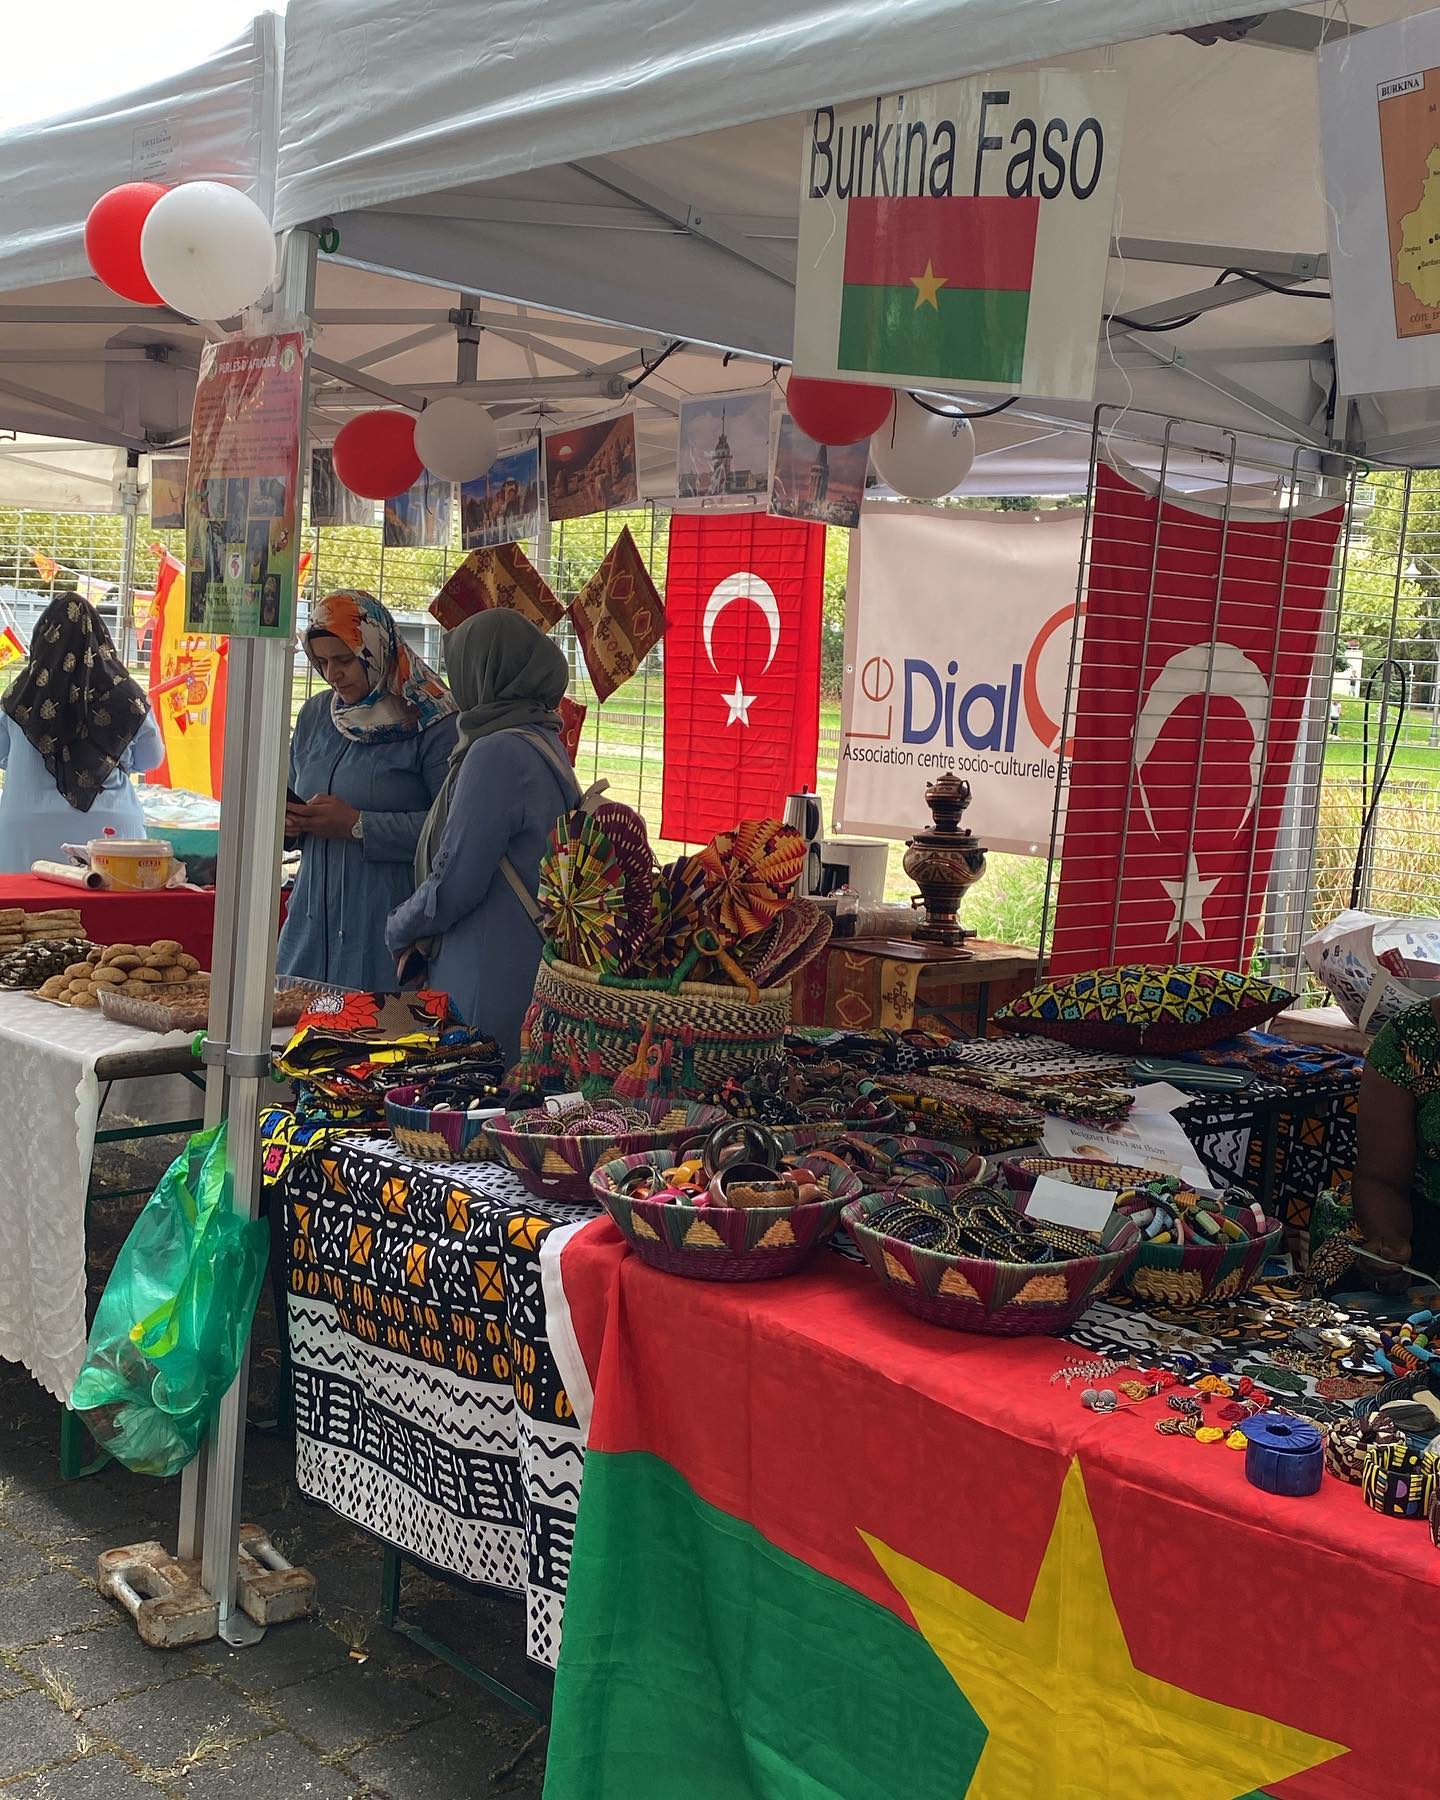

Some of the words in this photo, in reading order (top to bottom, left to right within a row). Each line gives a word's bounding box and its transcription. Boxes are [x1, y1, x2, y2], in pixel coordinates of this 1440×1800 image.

[1381, 79, 1420, 97] BURKINA
[809, 96, 956, 199] Burkina
[974, 91, 1104, 199] Faso
[843, 742, 913, 766] Association
[917, 751, 955, 769] centre
[958, 755, 1055, 780] socio-culturelle
[1069, 1129, 1104, 1143] Beignet
[1106, 1136, 1128, 1148] farci
[1144, 1144, 1166, 1156] thon
